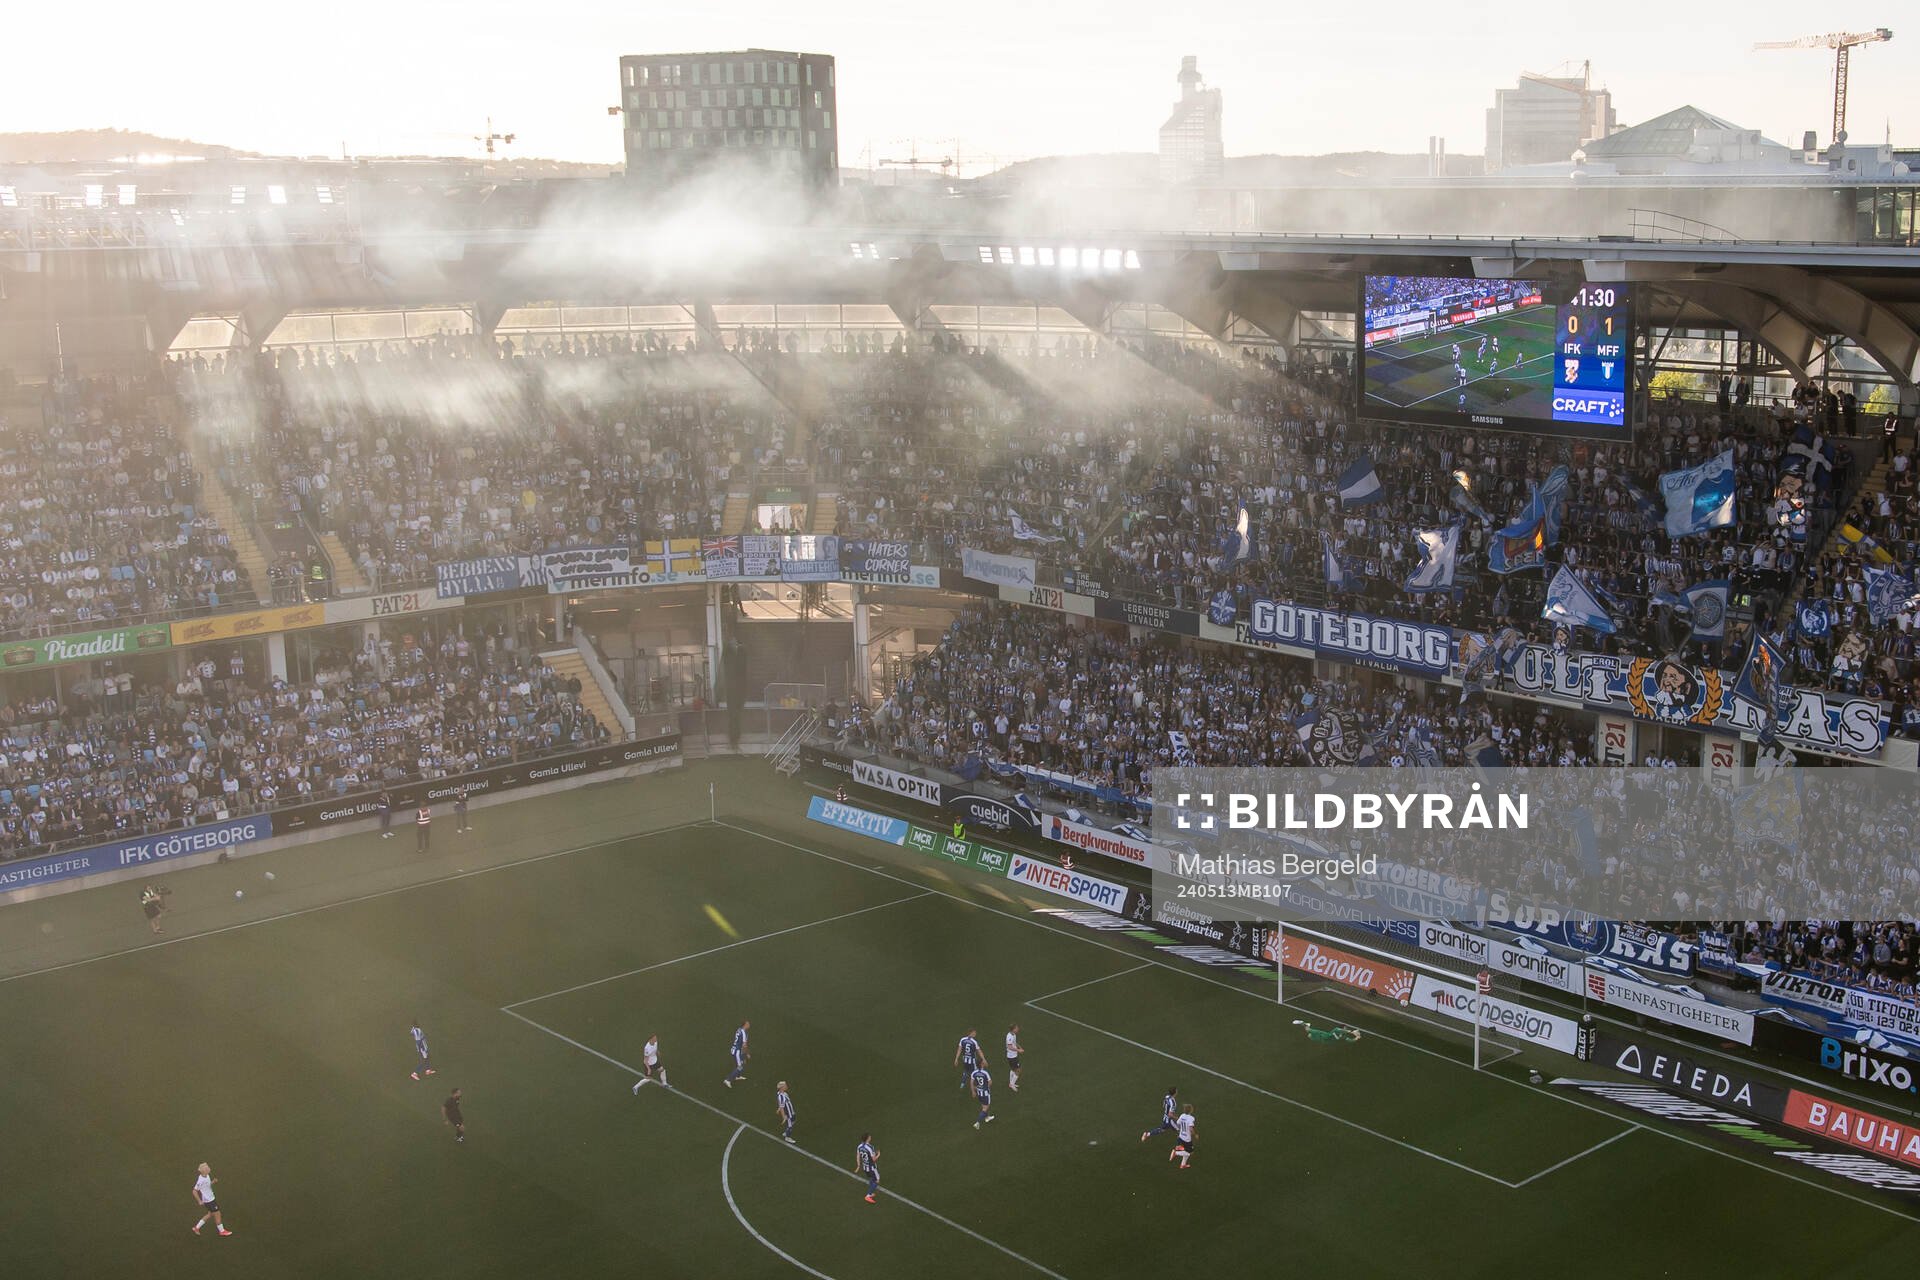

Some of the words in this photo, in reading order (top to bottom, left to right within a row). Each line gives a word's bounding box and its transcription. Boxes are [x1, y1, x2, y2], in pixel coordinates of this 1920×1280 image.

[1568, 315, 1578, 334] 0
[1605, 317, 1612, 335] 1
[1564, 343, 1581, 355] IFK
[1597, 344, 1620, 357] MFF
[1552, 398, 1609, 413] CRAFT
[1471, 415, 1504, 425] SAMSUNG
[868, 542, 908, 558] HATERS
[865, 558, 910, 573] CORNER
[372, 592, 421, 616] FAT21
[1030, 586, 1064, 610] FAT21
[44, 632, 125, 661] Picadeli
[624, 747, 652, 762] Gamla
[653, 742, 678, 755] Ullevi
[529, 763, 559, 779] Gamla
[561, 759, 587, 773] Ullevi
[856, 764, 894, 789] WASA
[897, 777, 939, 802] OPTIK
[320, 803, 354, 821] Gamla
[355, 795, 384, 814] Ullev
[970, 803, 1011, 827] cuebid
[119, 843, 151, 865] IFK
[154, 823, 256, 858] GÖTEBORG
[912, 830, 933, 846] MCR
[946, 841, 967, 858] MCR
[1062, 829, 1146, 862] Bergkvarabuss
[981, 852, 1003, 868] MCR
[1026, 863, 1121, 906] INTERSPORT
[1162, 900, 1213, 924] Göteborgs
[1156, 911, 1224, 941] Metallpartier
[1426, 926, 1486, 956] granitor
[1300, 943, 1373, 988] Renova
[1502, 948, 1566, 982] granitor
[1765, 971, 1846, 1004] VIKTOR
[1607, 983, 1741, 1033] STENFASTIGHETER
[1877, 1016, 1895, 1029] 123
[1578, 1027, 1588, 1061] SELECT
[1652, 1055, 1752, 1107] ELEDA
